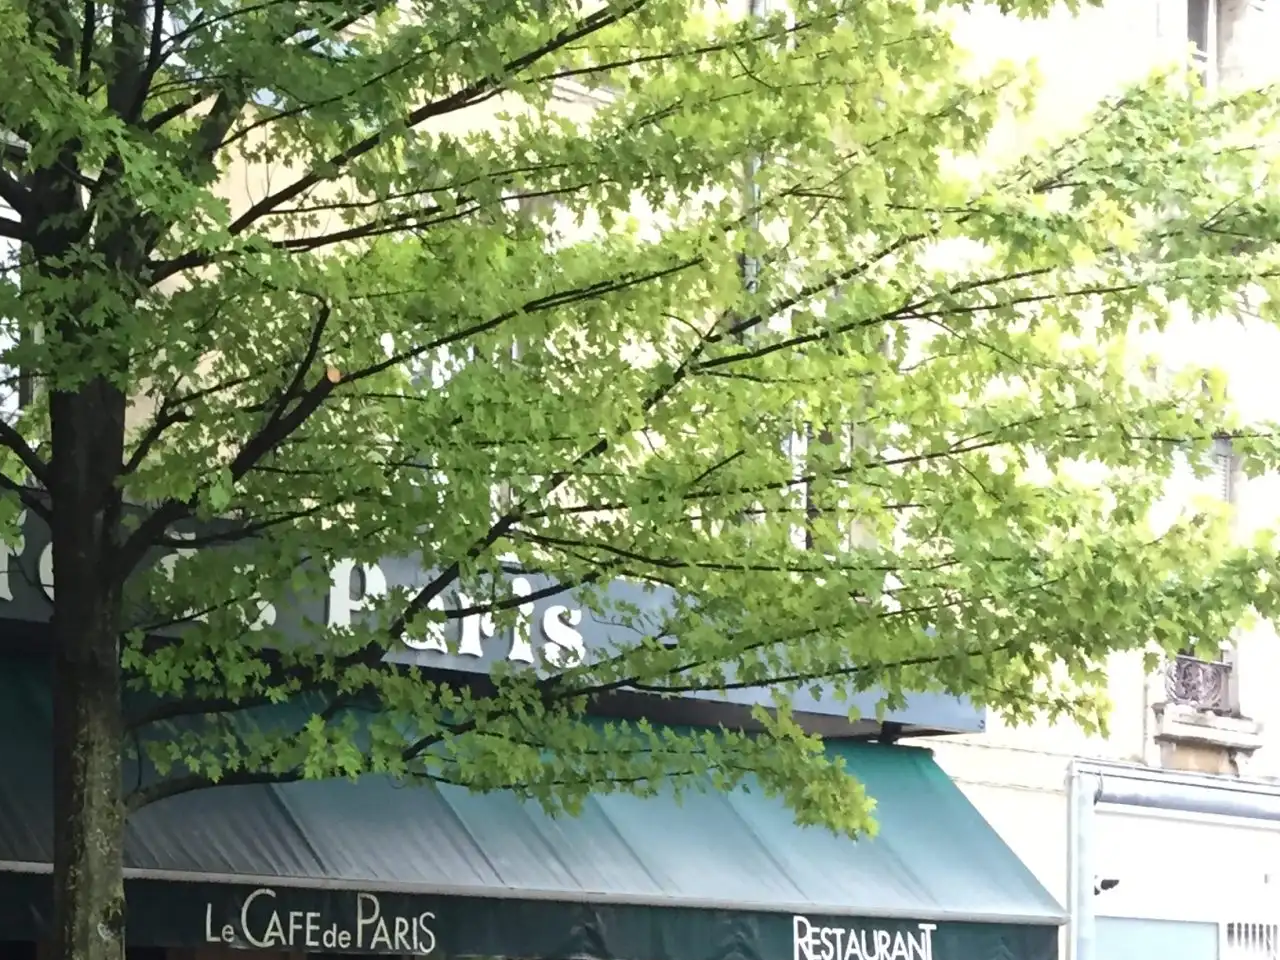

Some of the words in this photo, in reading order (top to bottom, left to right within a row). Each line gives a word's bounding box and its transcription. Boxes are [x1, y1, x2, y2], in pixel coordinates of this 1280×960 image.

[205, 902, 235, 943] Le
[241, 888, 321, 948] CAFE
[322, 922, 352, 949] de
[356, 892, 437, 953] PARIS
